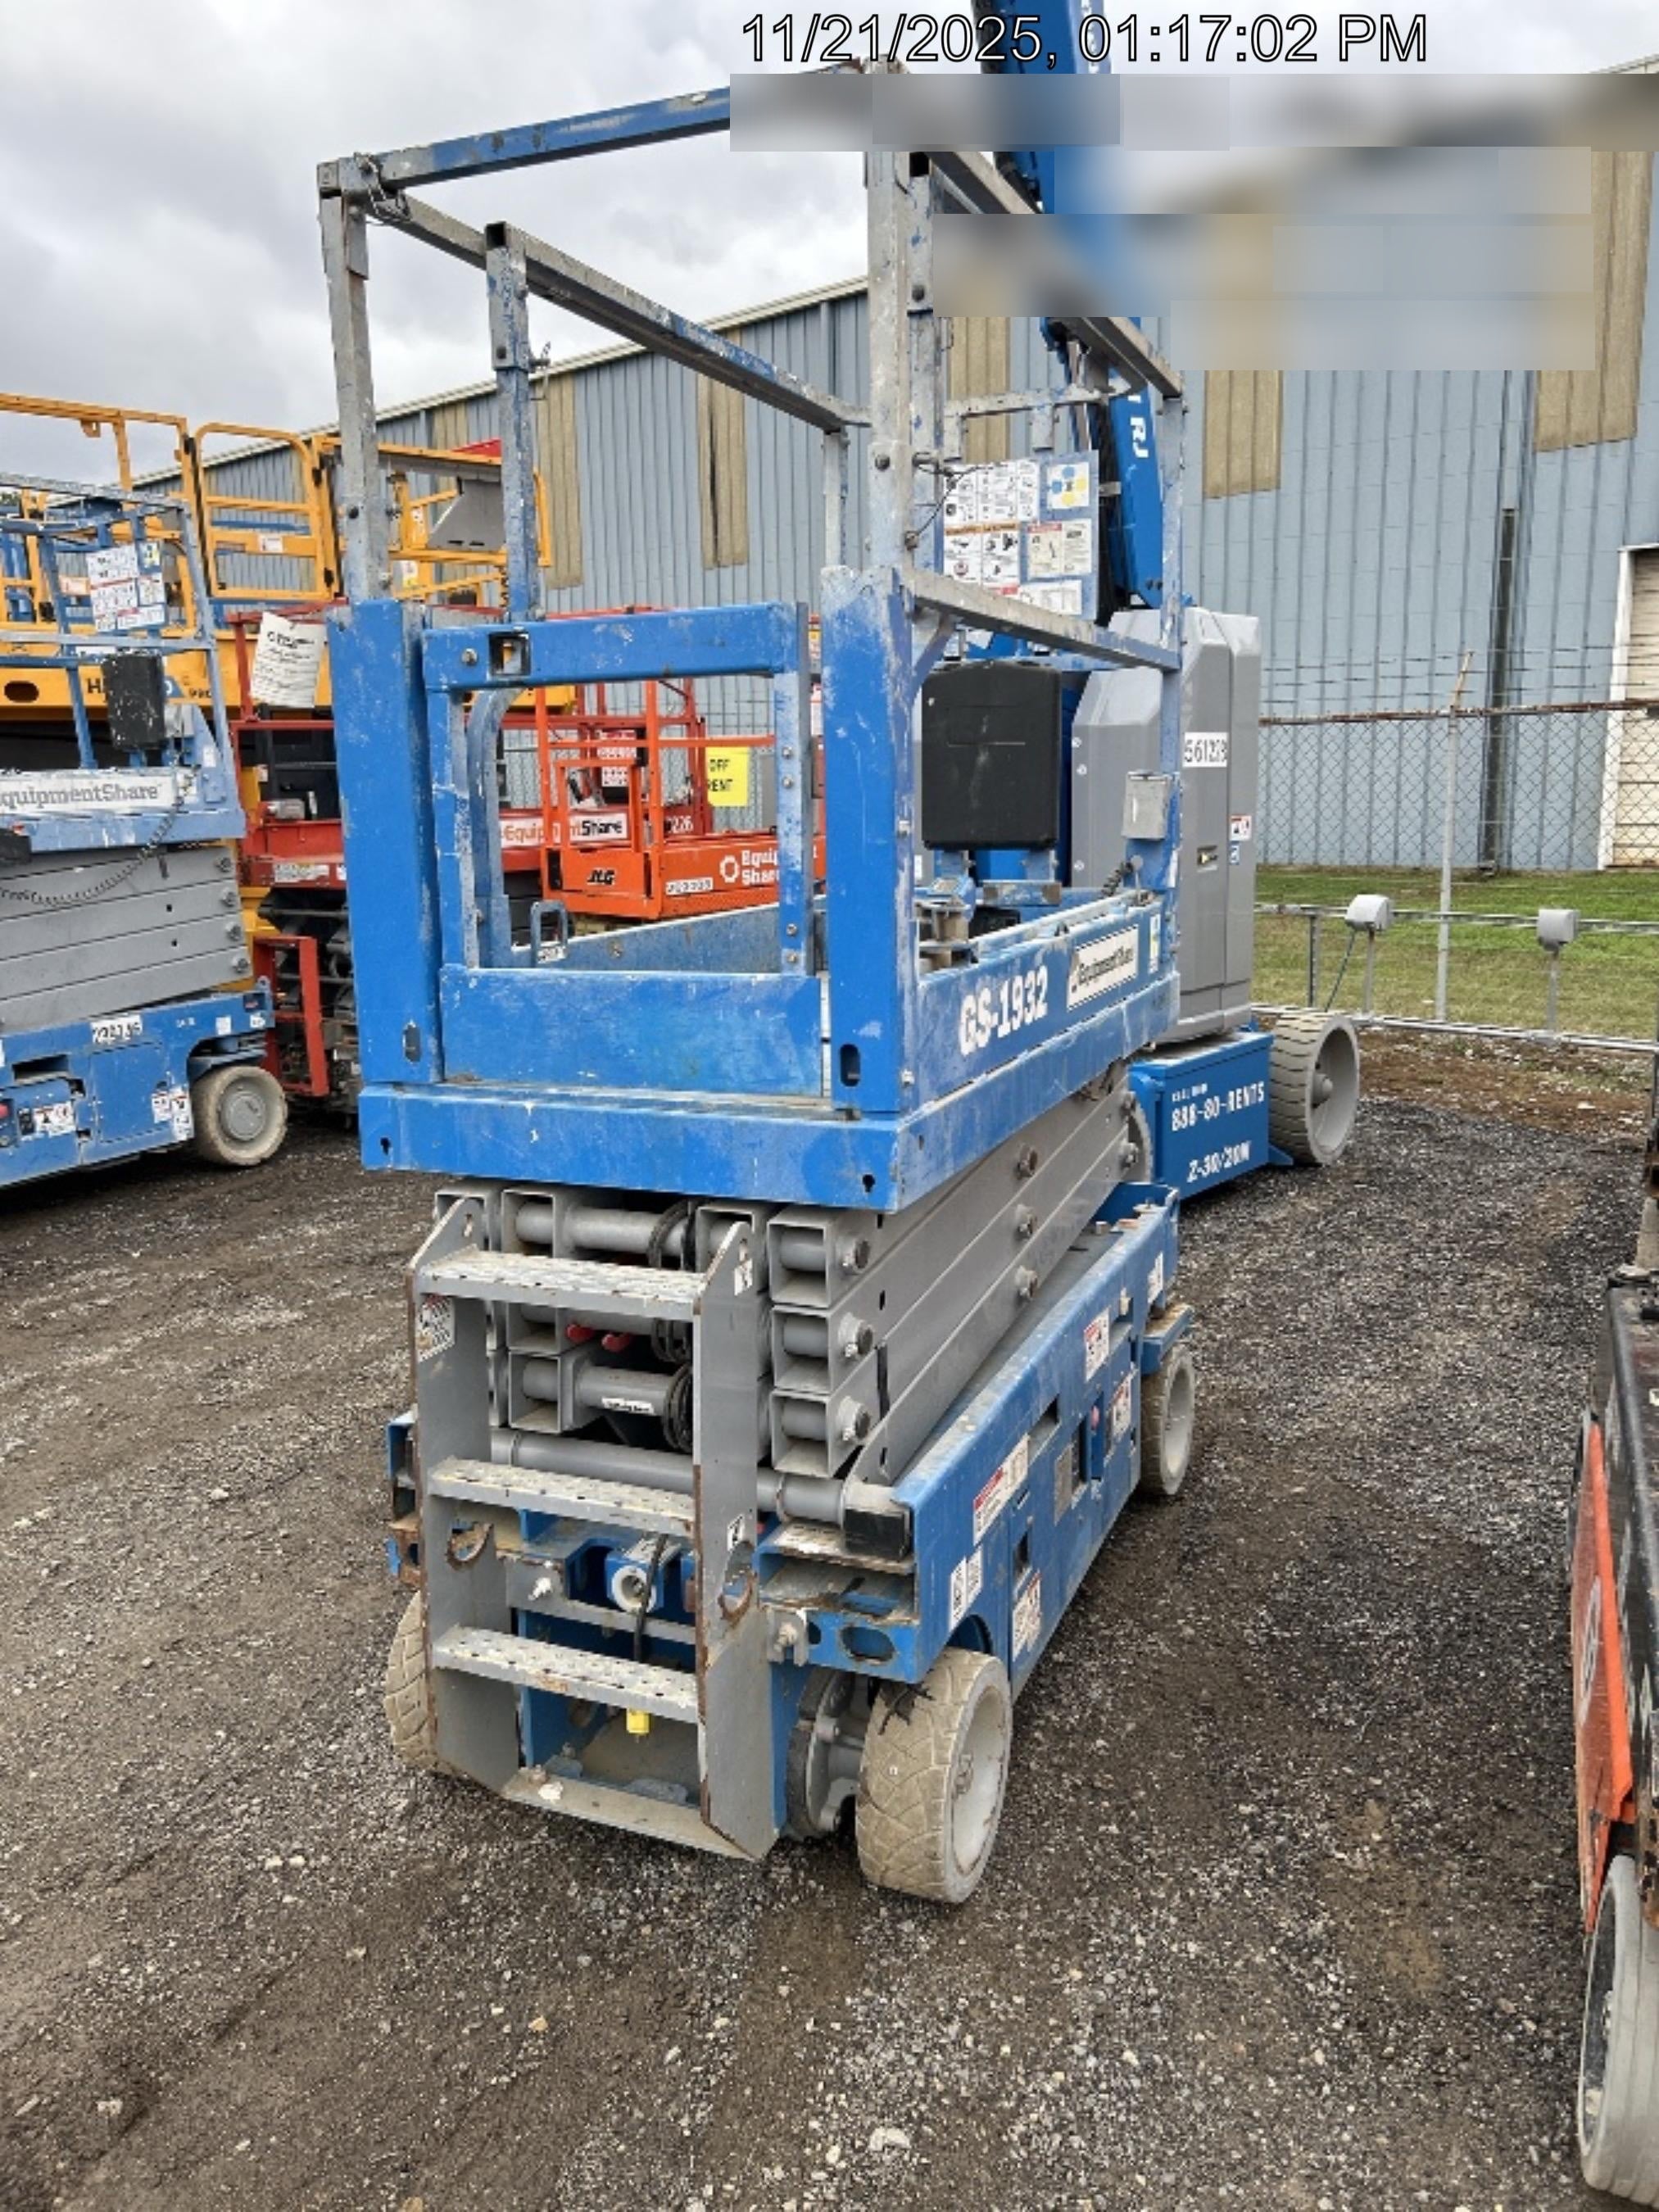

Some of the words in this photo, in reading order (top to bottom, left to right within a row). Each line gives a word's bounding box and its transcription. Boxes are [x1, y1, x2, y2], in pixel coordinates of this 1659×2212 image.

[0, 783, 158, 809] quipmentShare
[587, 868, 615, 886] JLG
[959, 965, 1048, 1056] GS-1932
